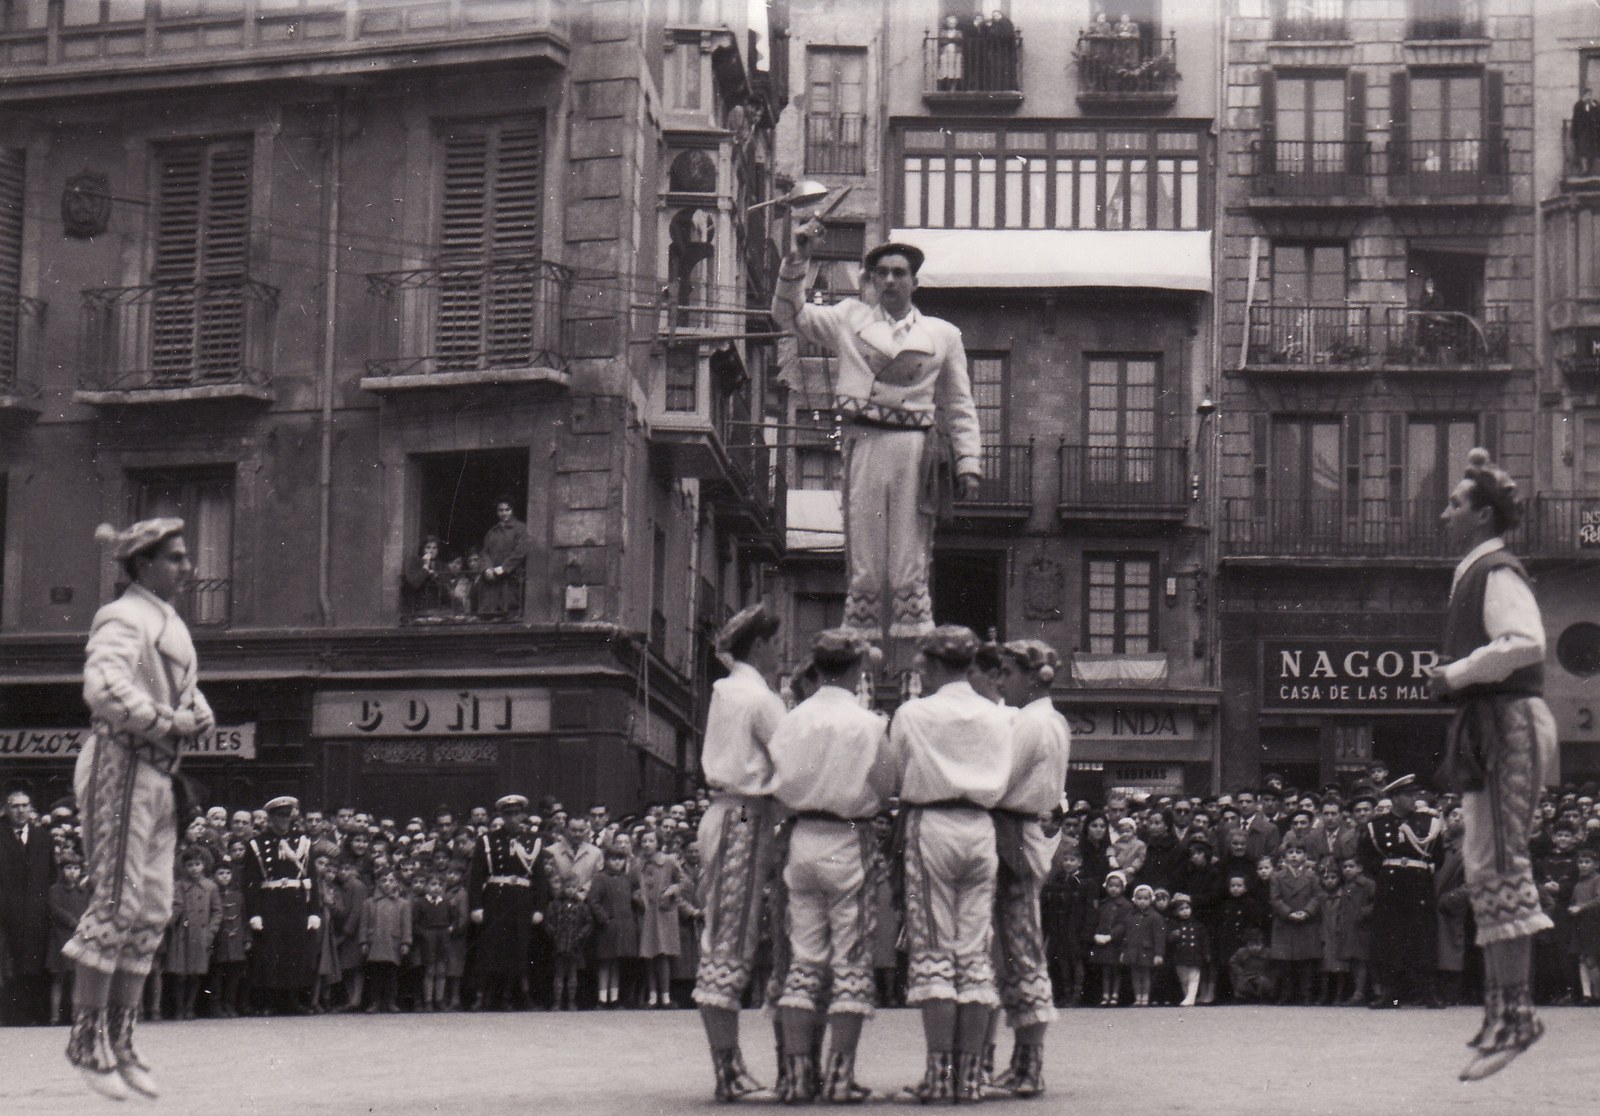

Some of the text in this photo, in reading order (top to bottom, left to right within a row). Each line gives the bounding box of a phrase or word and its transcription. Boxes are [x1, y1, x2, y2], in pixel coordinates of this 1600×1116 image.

[1280, 684, 1430, 700] CASA DE LAS MAL
[1111, 709, 1179, 736] INDA
